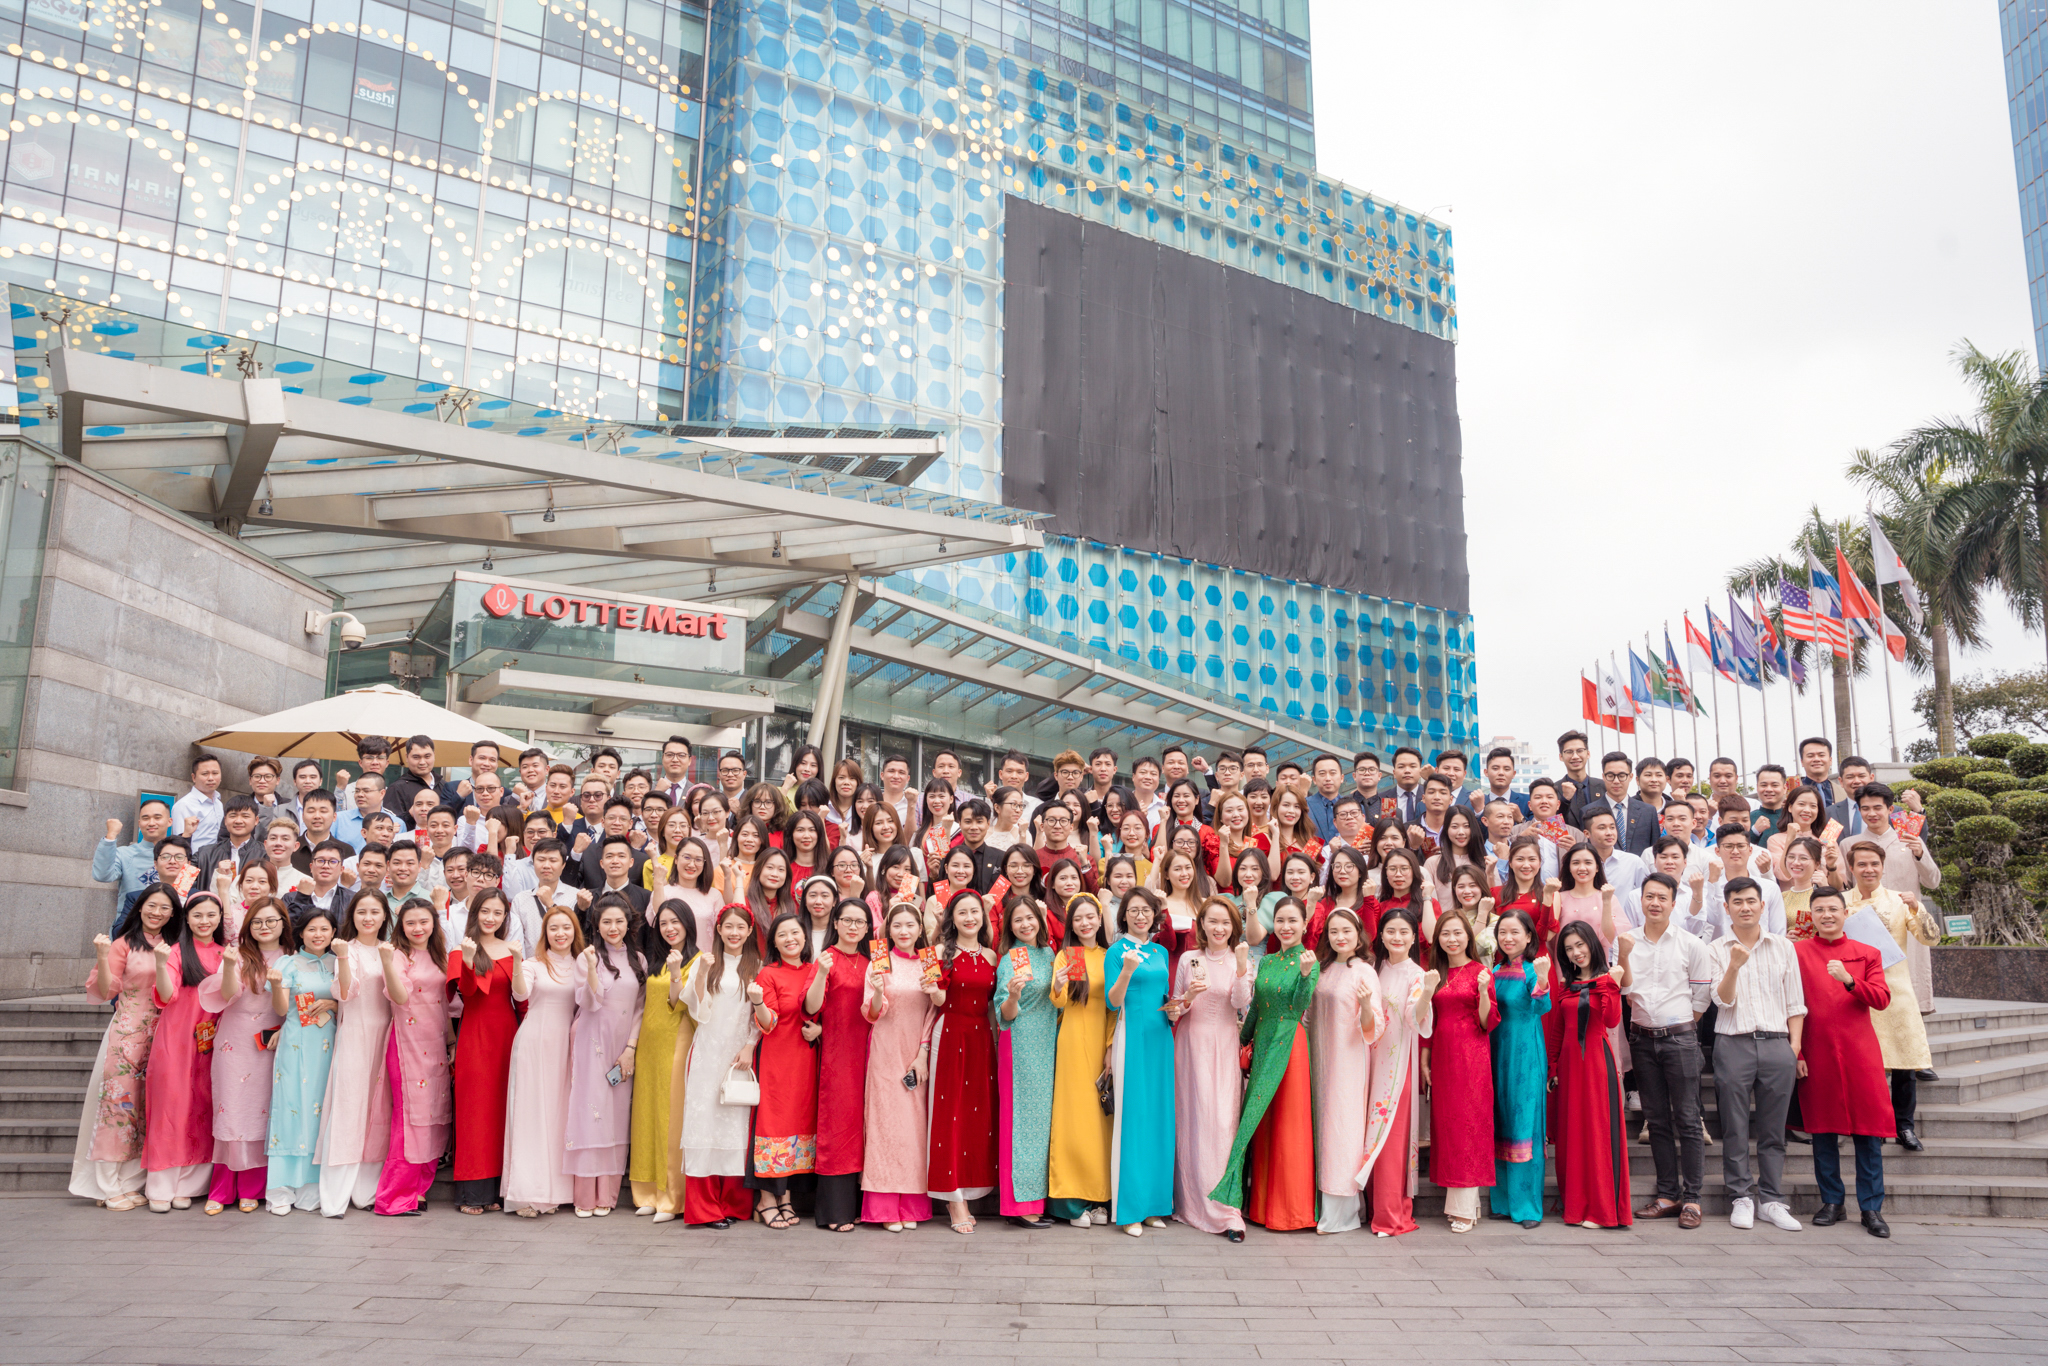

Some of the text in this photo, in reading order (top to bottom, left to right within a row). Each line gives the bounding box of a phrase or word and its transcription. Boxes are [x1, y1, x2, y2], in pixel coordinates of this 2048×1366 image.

[63, 161, 179, 201] MANWAH
[63, 176, 178, 208] AIWANES HOTPO
[292, 205, 335, 225] dyson
[524, 592, 639, 629] LOTTE
[643, 604, 728, 640] Mart
